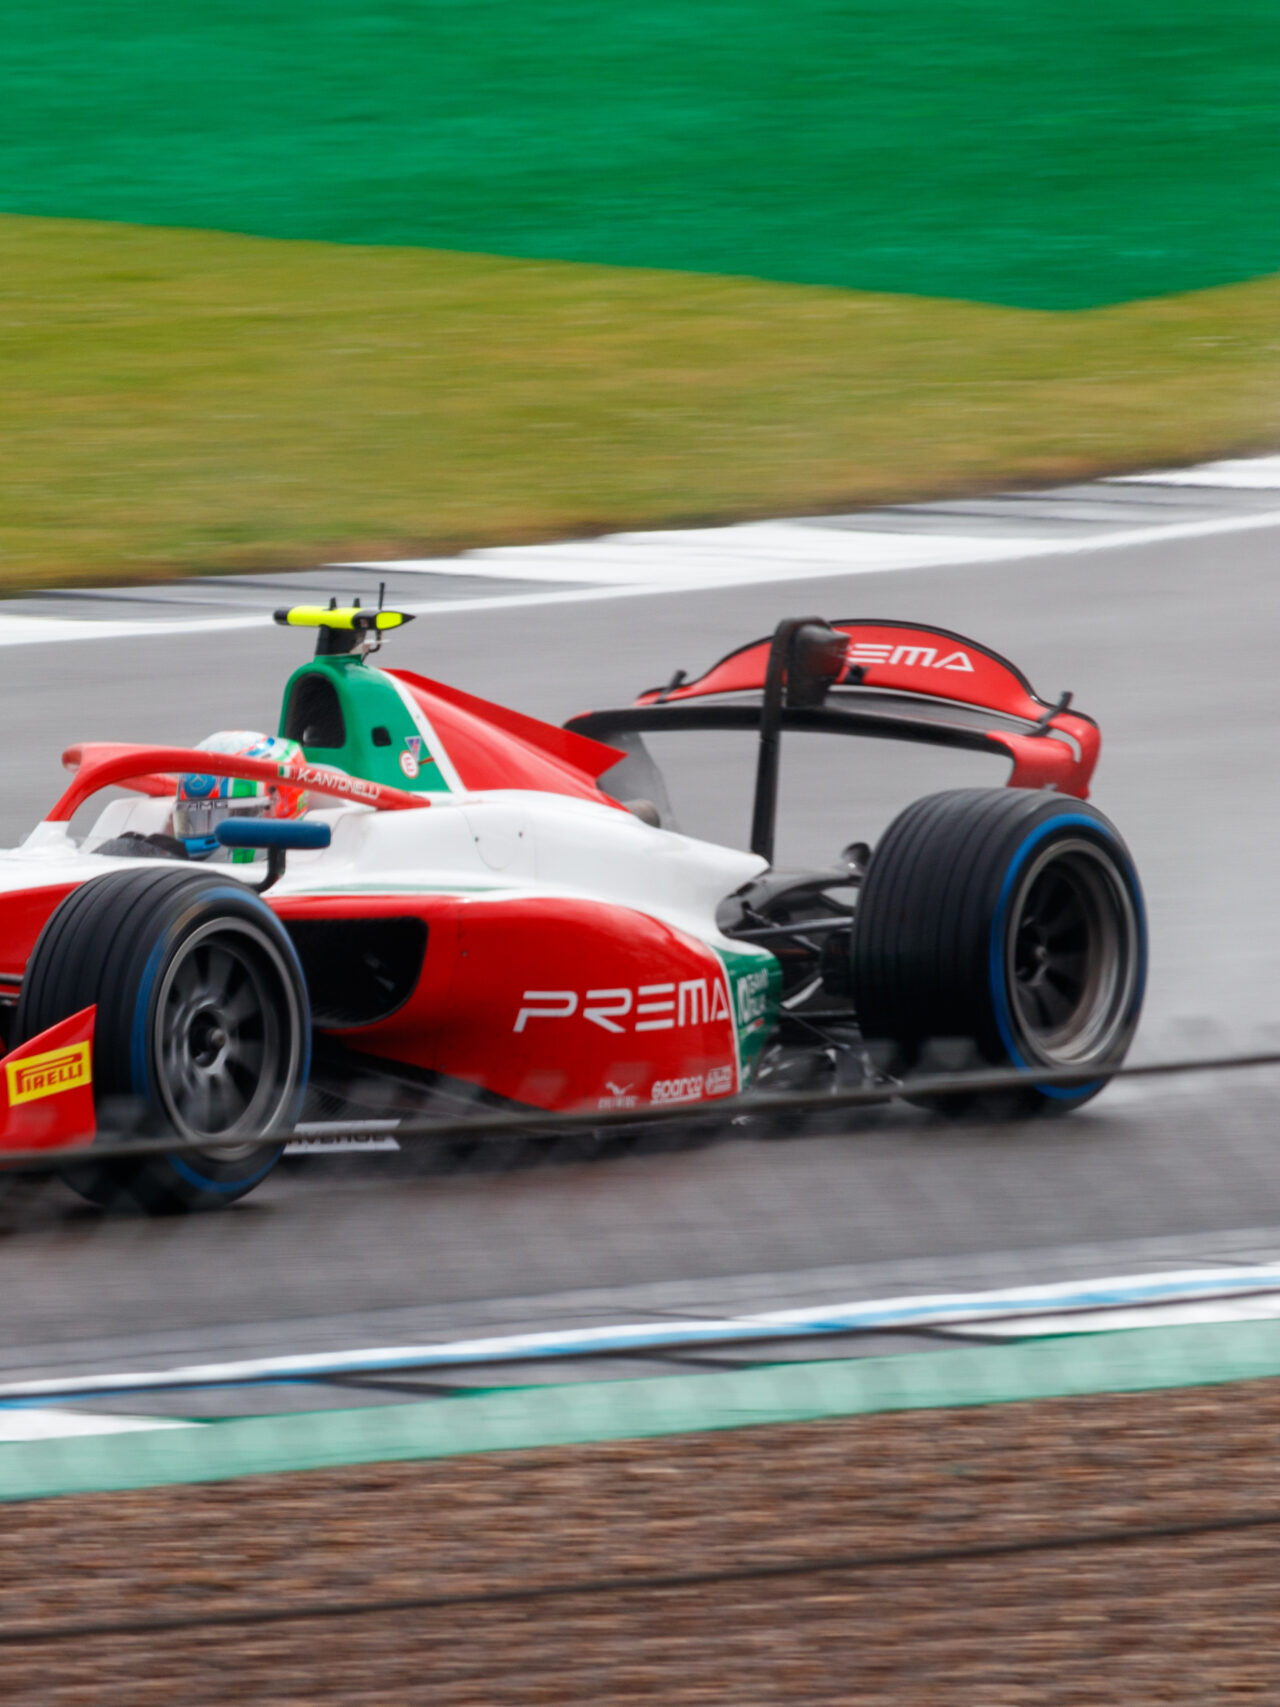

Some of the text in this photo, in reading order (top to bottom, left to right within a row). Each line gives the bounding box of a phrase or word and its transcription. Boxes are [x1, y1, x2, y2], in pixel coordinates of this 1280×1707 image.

[847, 643, 975, 673] EMA
[513, 977, 730, 1033] PREMA
[15, 1052, 83, 1096] PIRELLI
